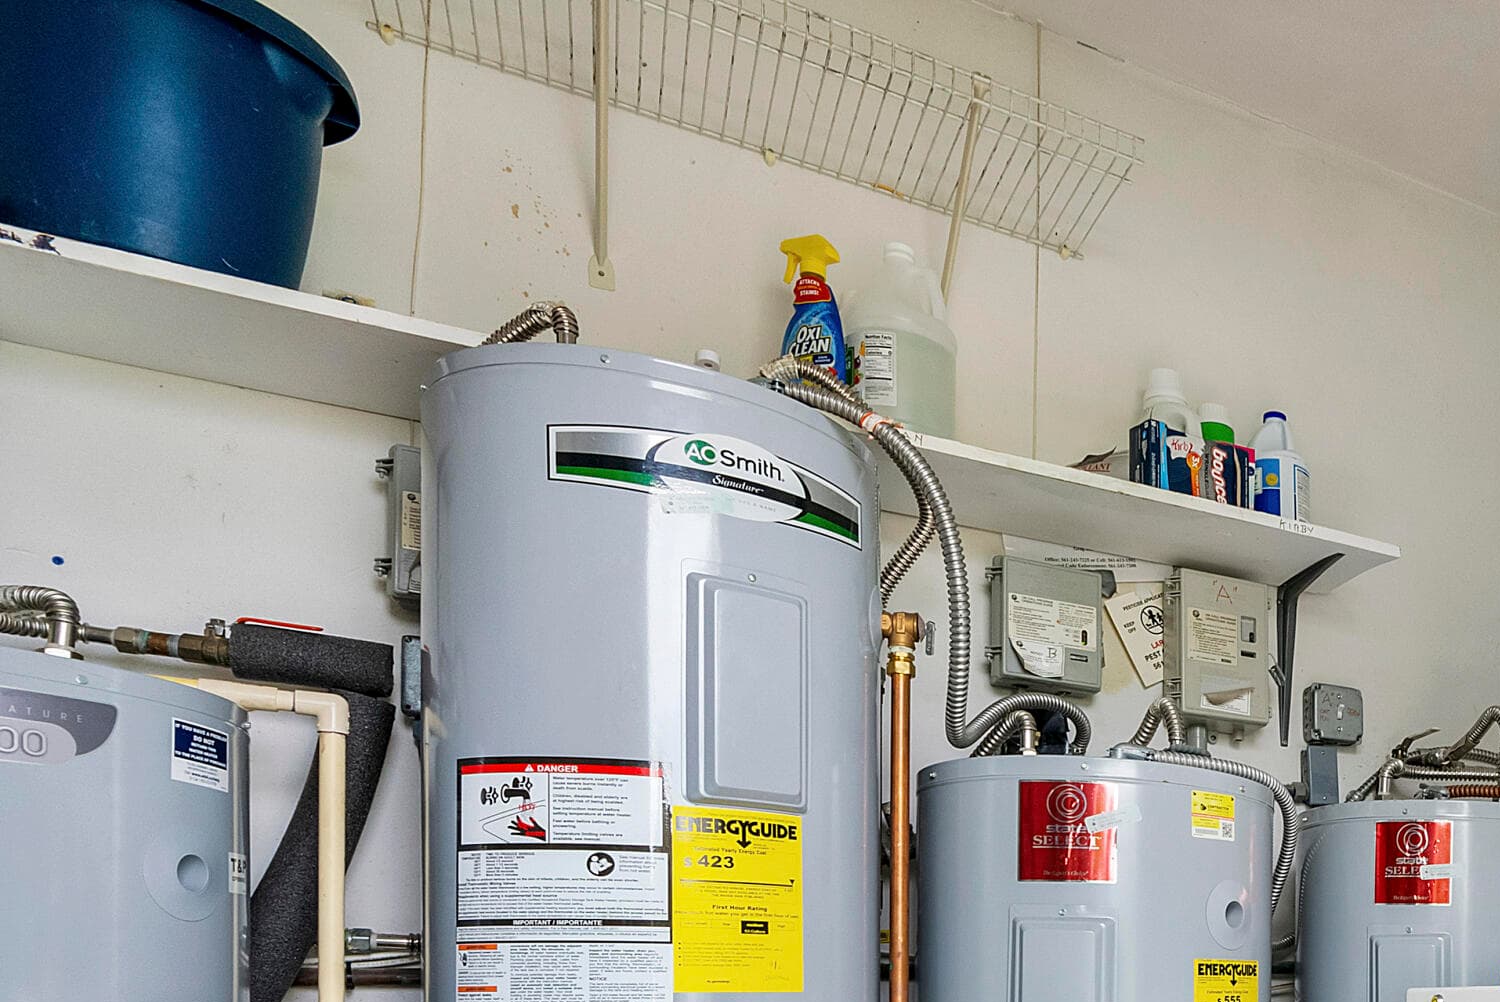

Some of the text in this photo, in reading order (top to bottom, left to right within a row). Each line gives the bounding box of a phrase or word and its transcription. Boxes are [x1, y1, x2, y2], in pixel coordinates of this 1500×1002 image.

[796, 326, 821, 343] OXI
[789, 338, 830, 357] CLEAN
[1212, 448, 1227, 504] bounce
[712, 475, 761, 493] Signature
[1144, 650, 1161, 661] PEST
[537, 764, 578, 773] DANGER
[675, 815, 798, 841] ENERGYGUIDE
[1032, 834, 1102, 847] SELECT
[697, 854, 735, 868] 423
[1385, 866, 1420, 875] SELE
[1197, 963, 1258, 977] ENERGYGUIDE
